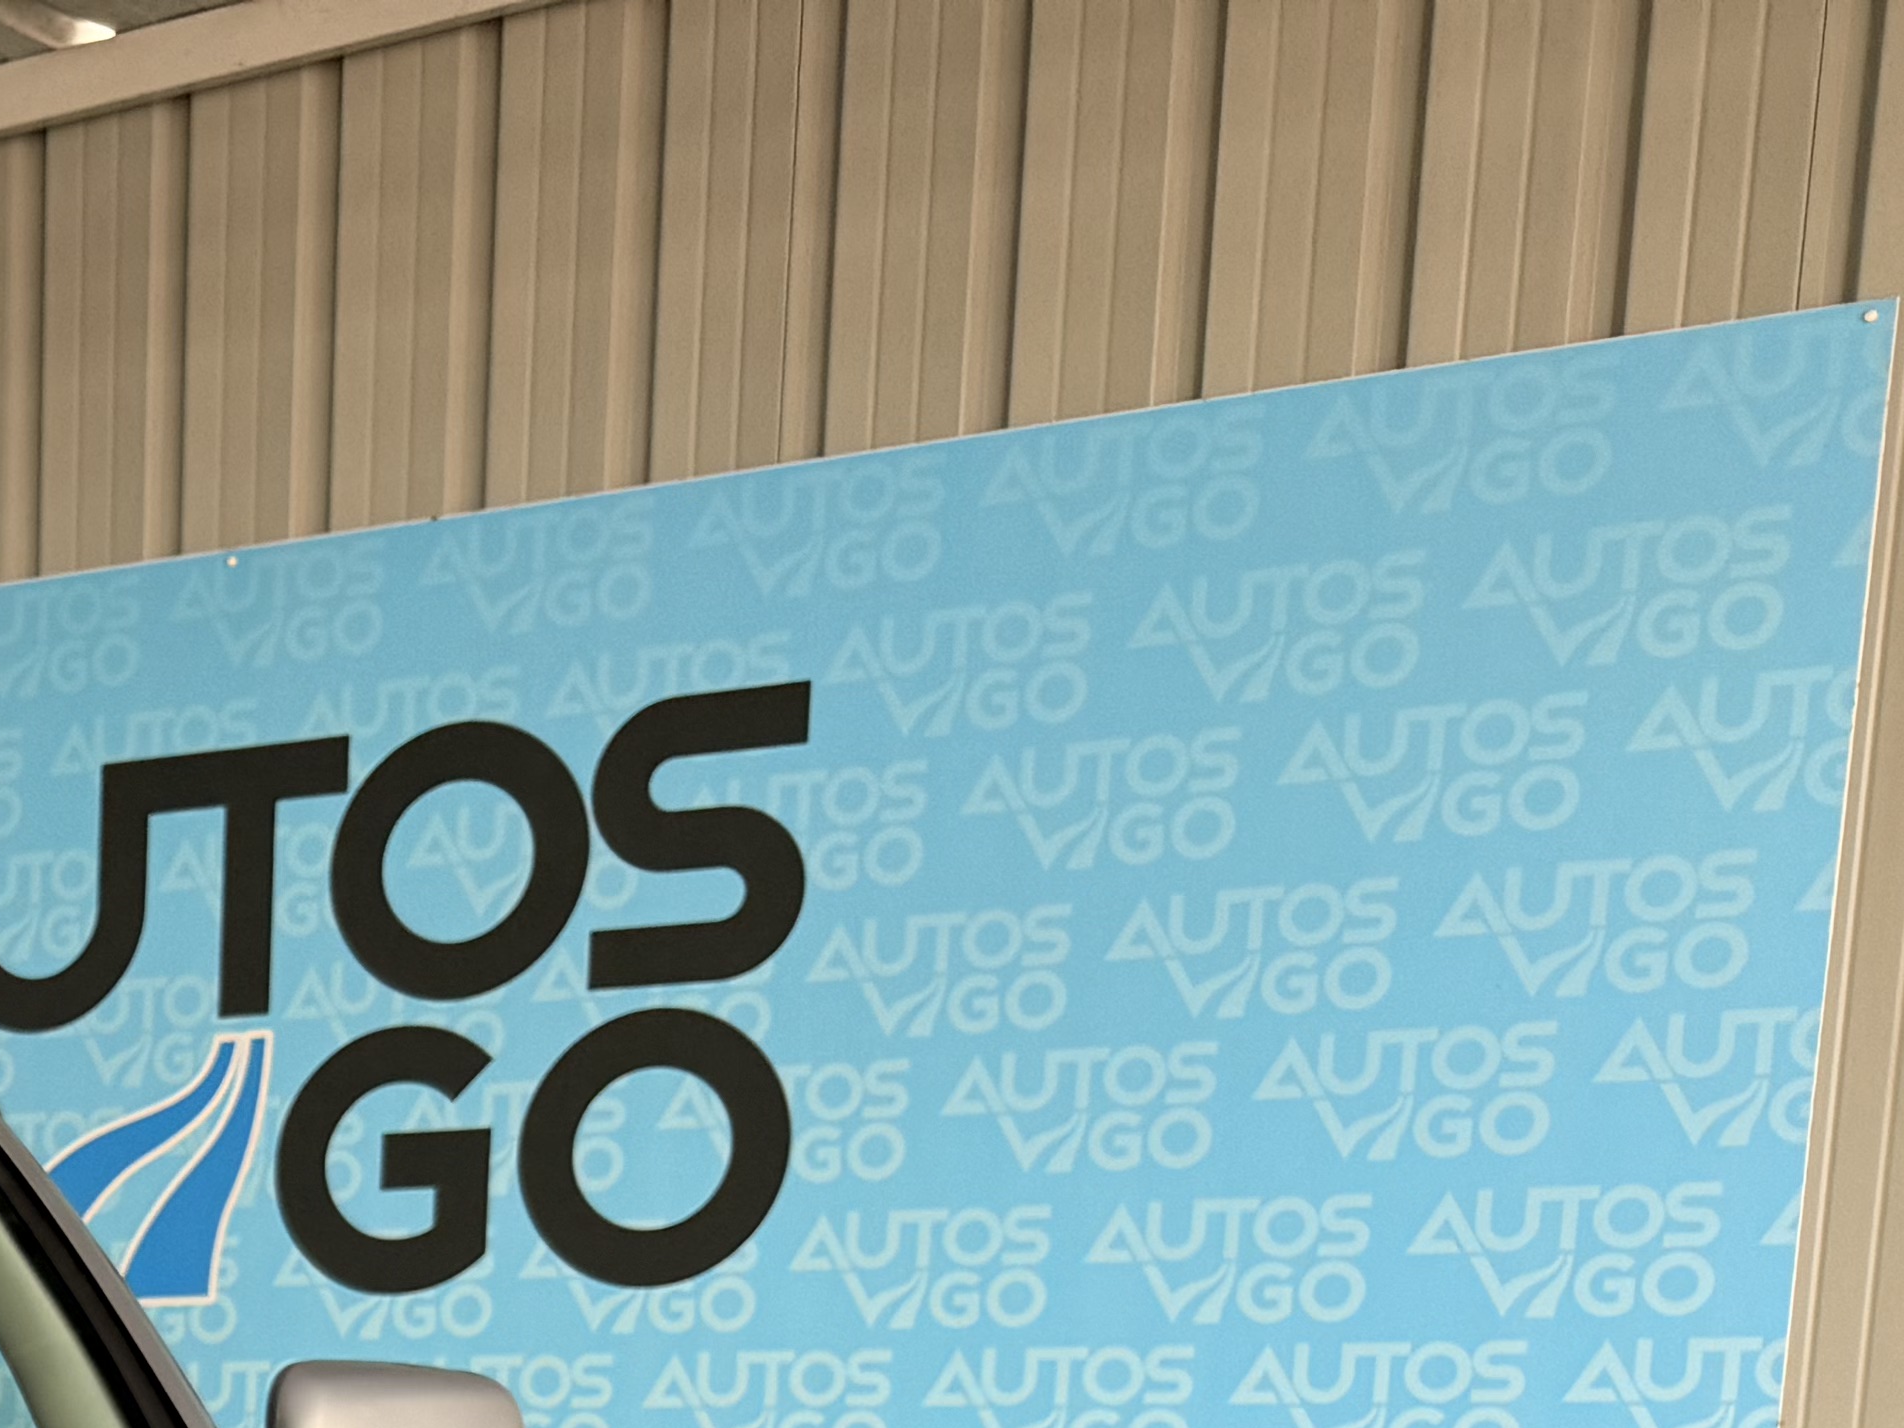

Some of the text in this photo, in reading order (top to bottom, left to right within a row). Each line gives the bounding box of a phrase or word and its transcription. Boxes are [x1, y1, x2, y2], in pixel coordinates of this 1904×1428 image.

[1460, 503, 1789, 609] AUTOS
[1125, 550, 1422, 648] AUTOS
[1527, 581, 1782, 666] VIGO
[819, 592, 1090, 684] AUTOS
[1185, 623, 1417, 703] VIGO
[875, 662, 1086, 737] VIGO
[958, 726, 1239, 814] AUTOS
[1274, 690, 1584, 784] AUTOS
[1015, 796, 1234, 869] VIGO
[1337, 764, 1578, 841] VIGO
[1103, 876, 1395, 959] AUTOS
[1432, 847, 1755, 935] AUTOS
[803, 903, 1069, 981] AUTOS
[1498, 921, 1747, 995] VIGO
[857, 969, 1065, 1036] VIGO
[1163, 946, 1390, 1017] VIGO
[939, 1040, 1215, 1114] AUTOS
[1250, 1019, 1554, 1098] AUTOS
[995, 1107, 1210, 1172] VIGO
[1312, 1090, 1548, 1158] VIGO
[787, 1204, 1048, 1270] AUTOS
[1082, 1192, 1369, 1261] AUTOS
[1405, 1179, 1721, 1252] AUTOS
[313, 1284, 486, 1338] VIGO
[566, 1276, 753, 1333] VIGO
[841, 1269, 1044, 1328] VIGO
[1140, 1260, 1363, 1322] VIGO
[1469, 1250, 1714, 1316] VIGO
[641, 1349, 888, 1407] AUTOS
[921, 1344, 1192, 1405] AUTOS
[1227, 1339, 1525, 1403] AUTOS
